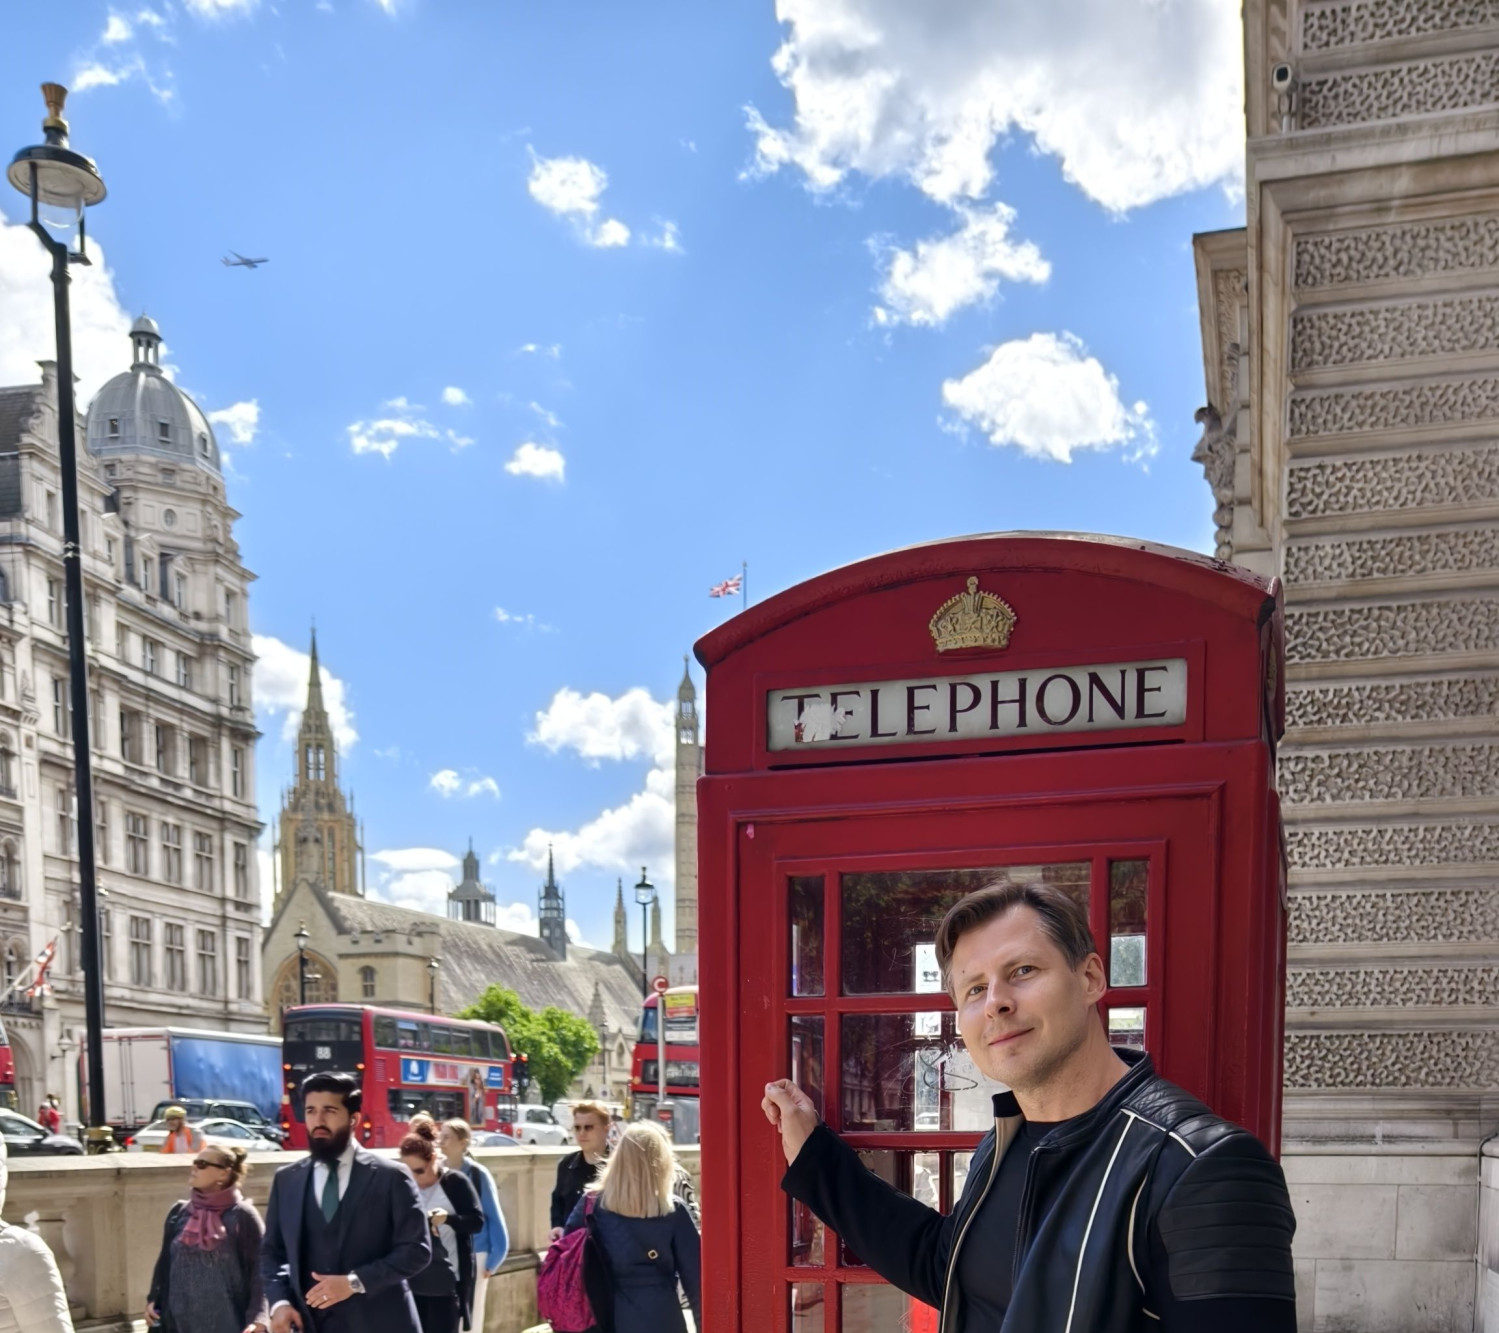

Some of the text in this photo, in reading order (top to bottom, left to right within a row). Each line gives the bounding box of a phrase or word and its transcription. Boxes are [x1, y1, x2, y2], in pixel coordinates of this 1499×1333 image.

[780, 665, 1169, 743] TELEPHONE
[654, 978, 666, 992] C
[316, 1046, 331, 1059] 88
